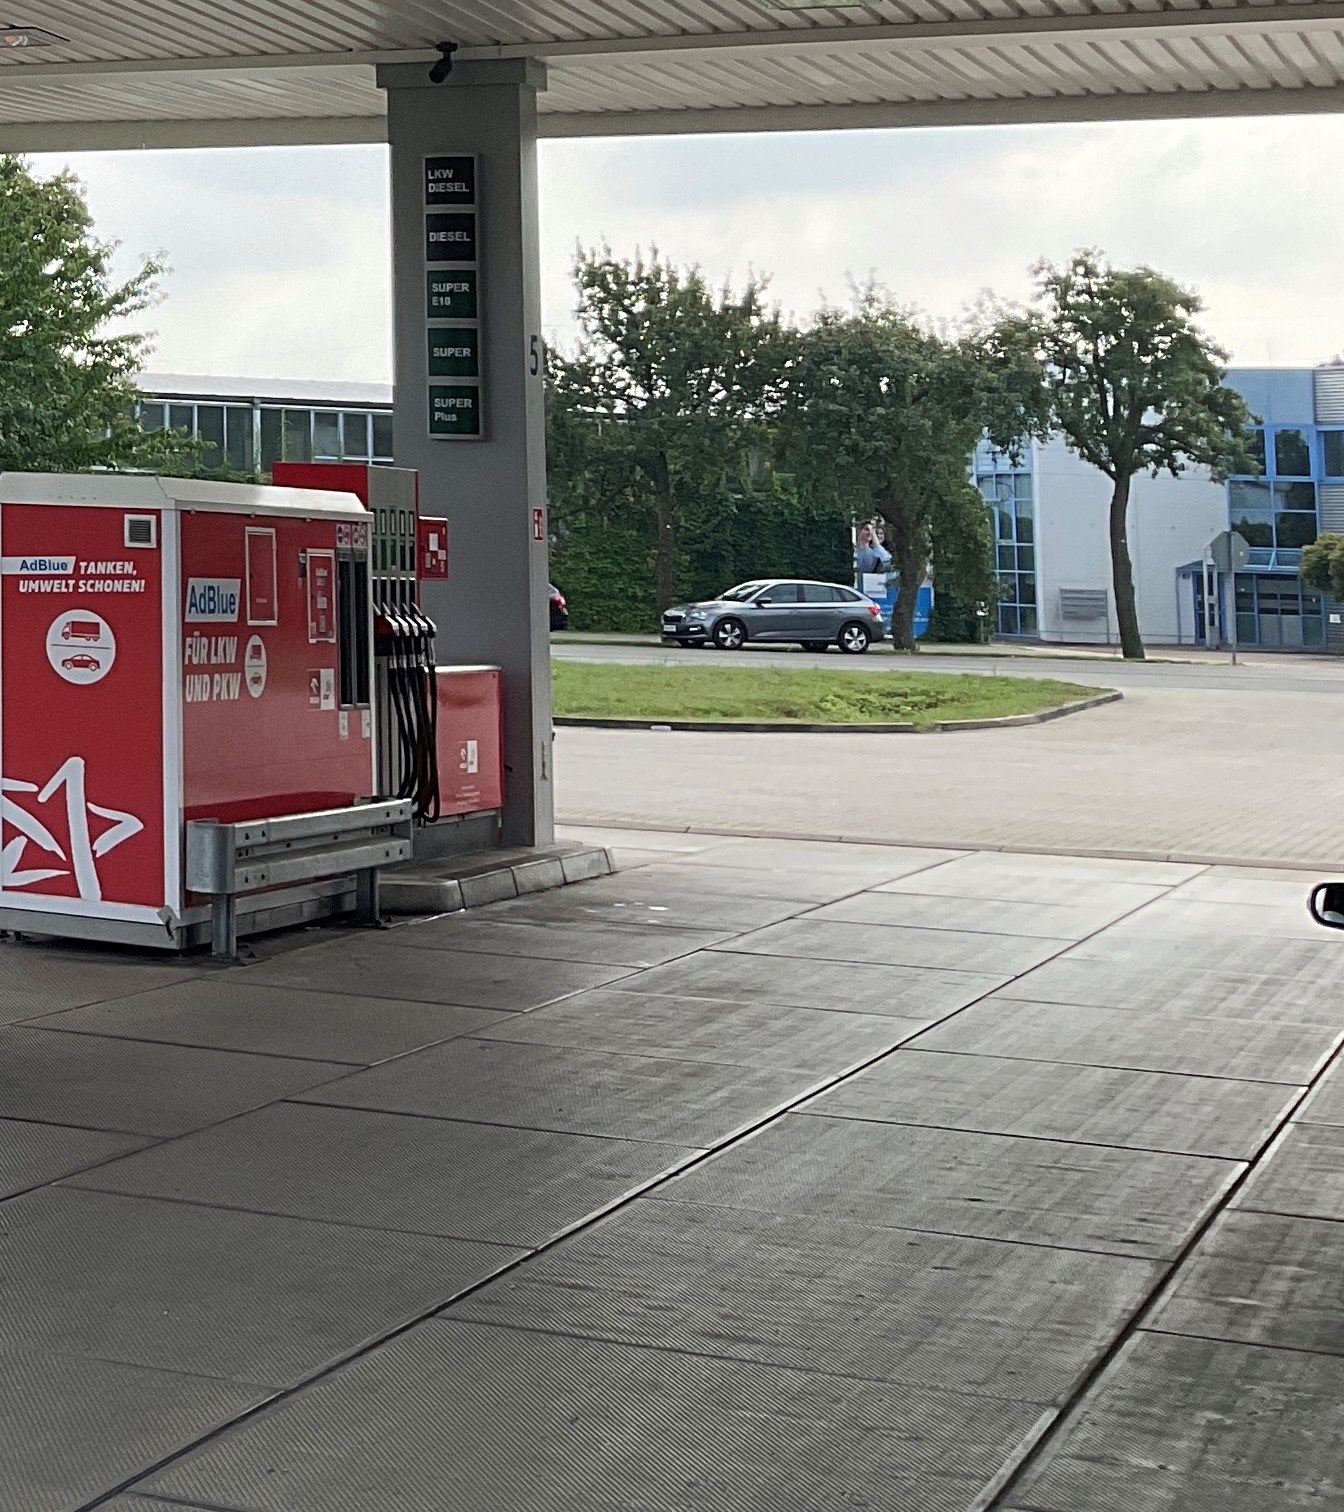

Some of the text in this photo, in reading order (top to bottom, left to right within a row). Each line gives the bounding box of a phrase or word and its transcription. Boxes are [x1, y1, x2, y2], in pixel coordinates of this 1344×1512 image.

[428, 169, 454, 180] LKW
[428, 182, 470, 193] DIESEL
[429, 231, 471, 242] DIESEL
[432, 283, 470, 293] SUPER
[432, 296, 451, 306] E10
[433, 347, 471, 357] SUPER
[530, 334, 539, 376] 5
[434, 398, 472, 408] SUPER
[434, 411, 457, 421] Plus
[19, 559, 137, 576] AdBlue TANKEN,
[19, 579, 146, 593] UMWELT SCHONEN!
[188, 585, 237, 615] AdBlue
[184, 631, 238, 665] FÜR LKW
[185, 672, 242, 703] UND PKW
